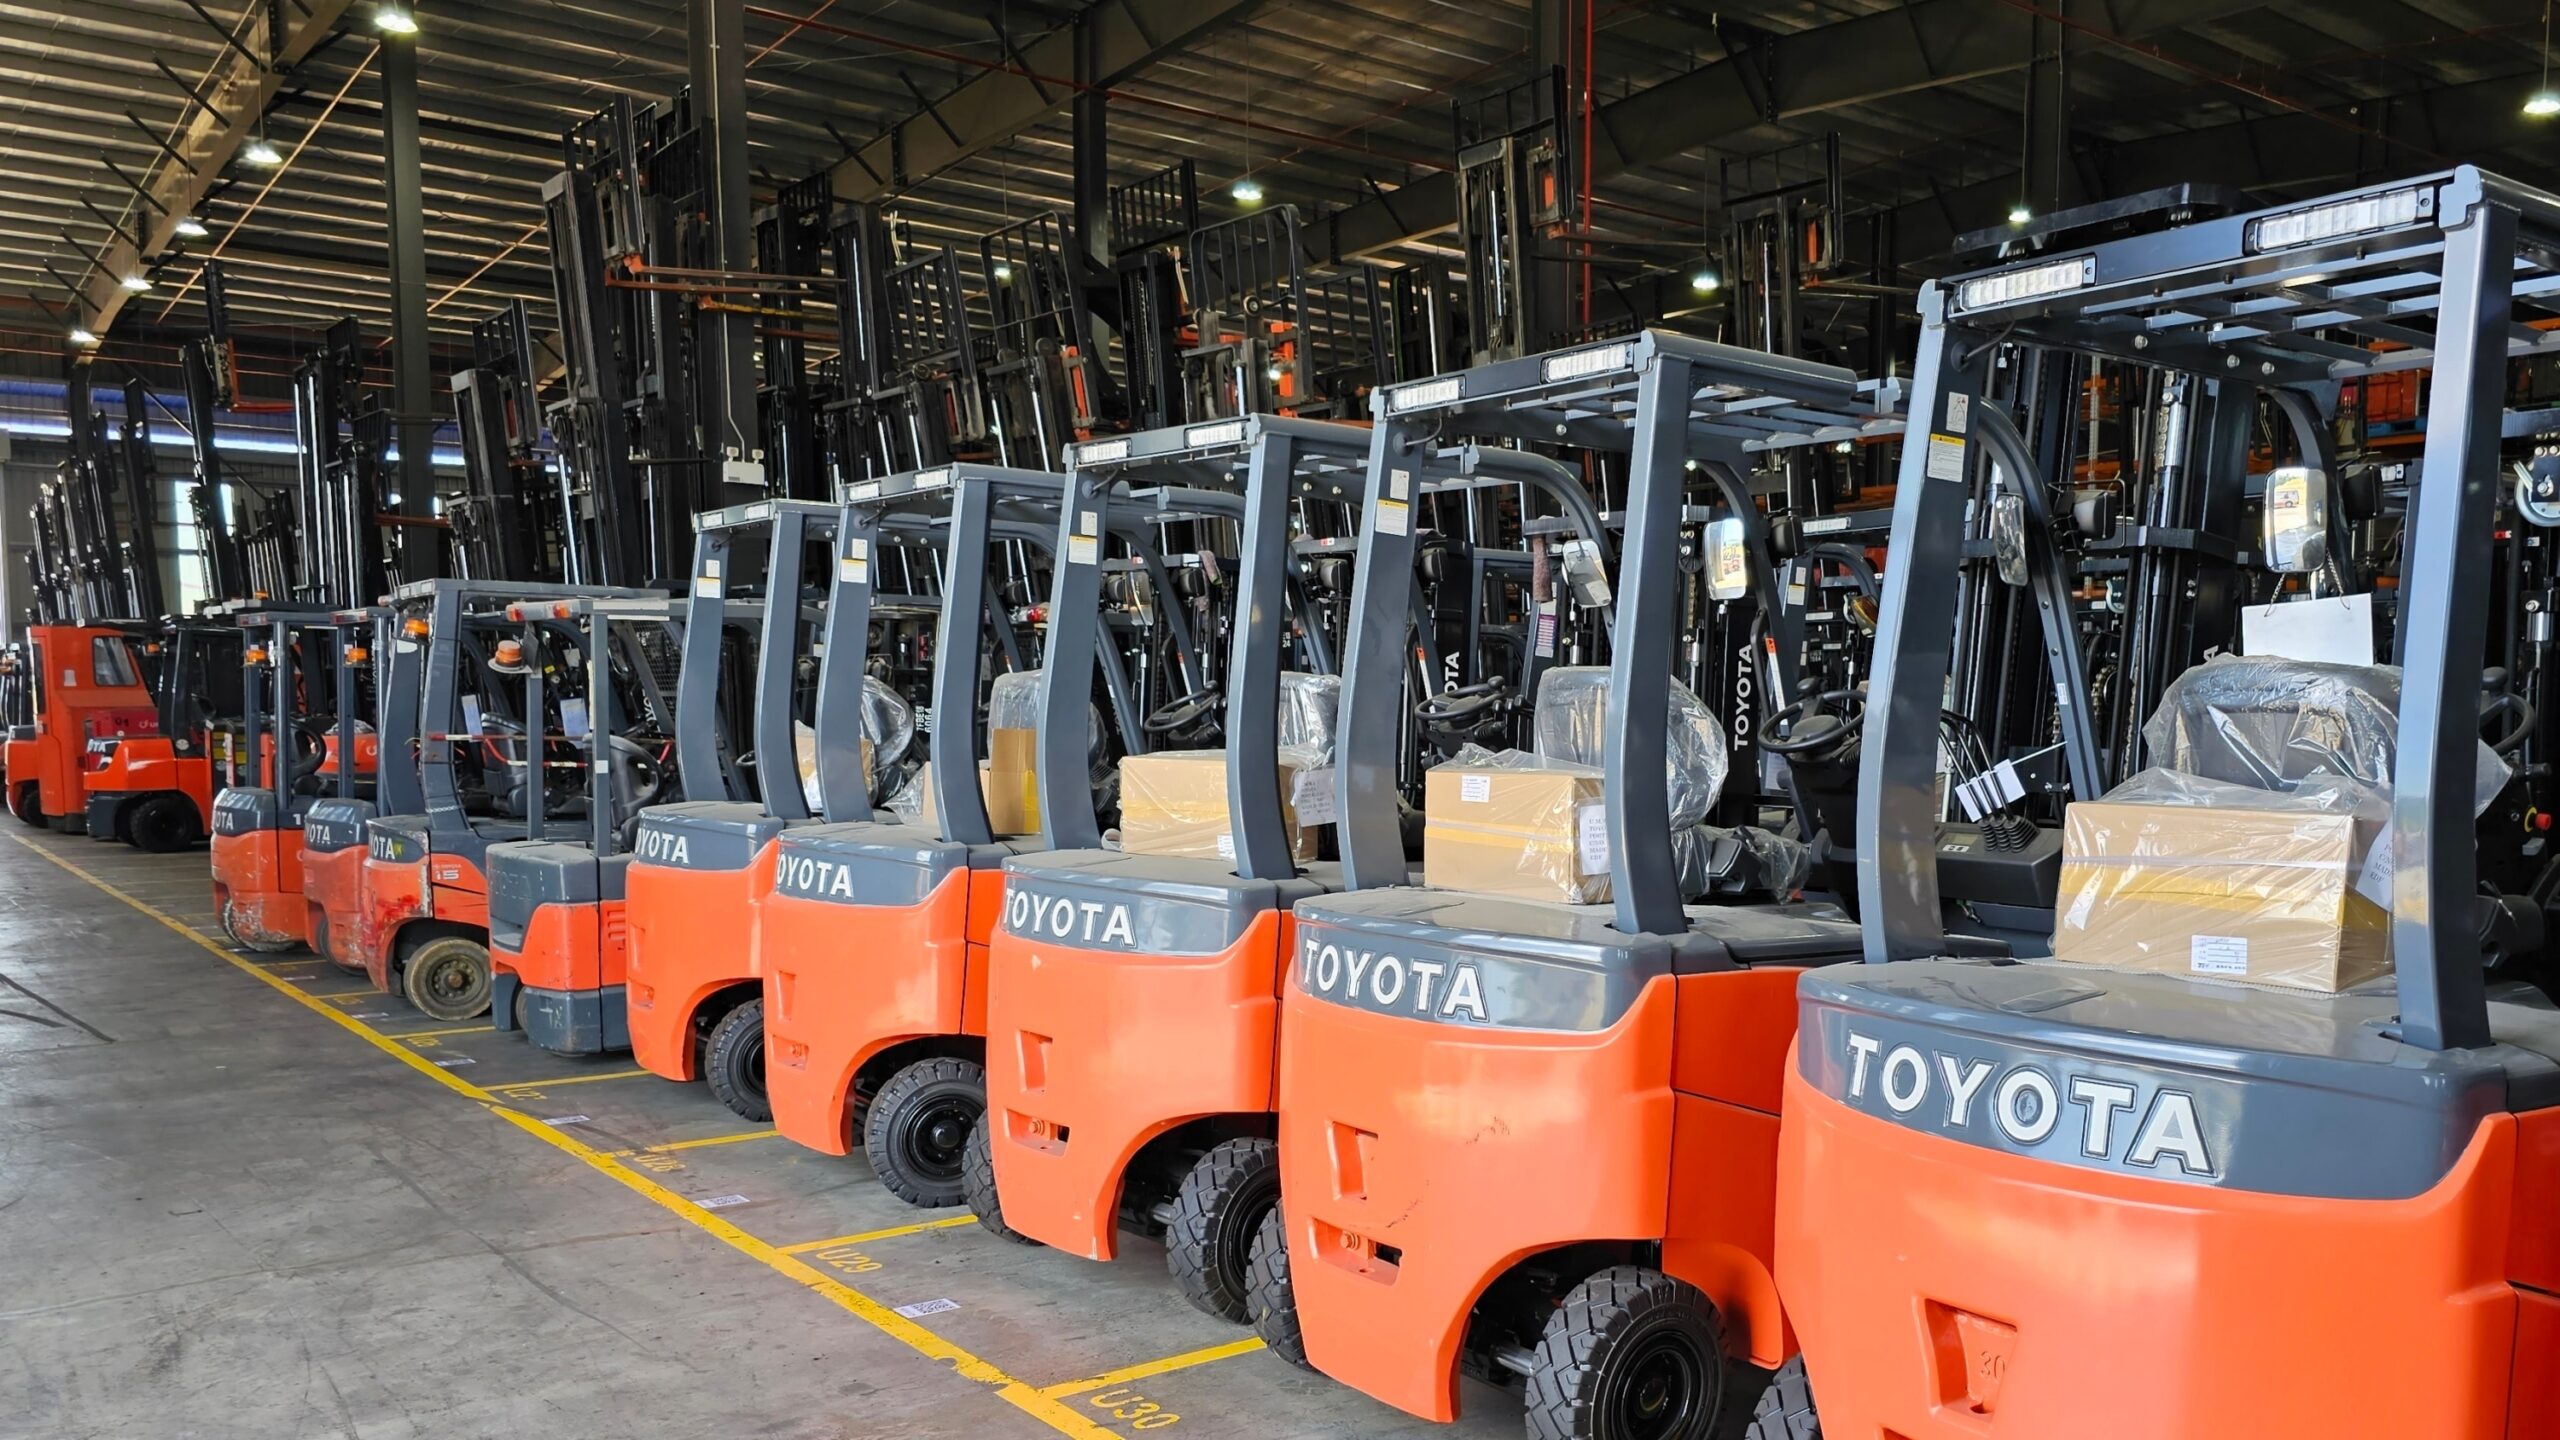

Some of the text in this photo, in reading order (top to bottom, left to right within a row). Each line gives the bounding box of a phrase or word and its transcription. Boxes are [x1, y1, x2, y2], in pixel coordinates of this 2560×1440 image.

[1734, 644, 1752, 751] TOYOTA
[1003, 887, 1136, 947] TOYOTA
[1303, 938, 1489, 1021] TOYOTA
[1847, 1030, 2217, 1177] TOYOTA
[816, 1248, 882, 1273] U29
[1090, 1389, 1180, 1429] U30
